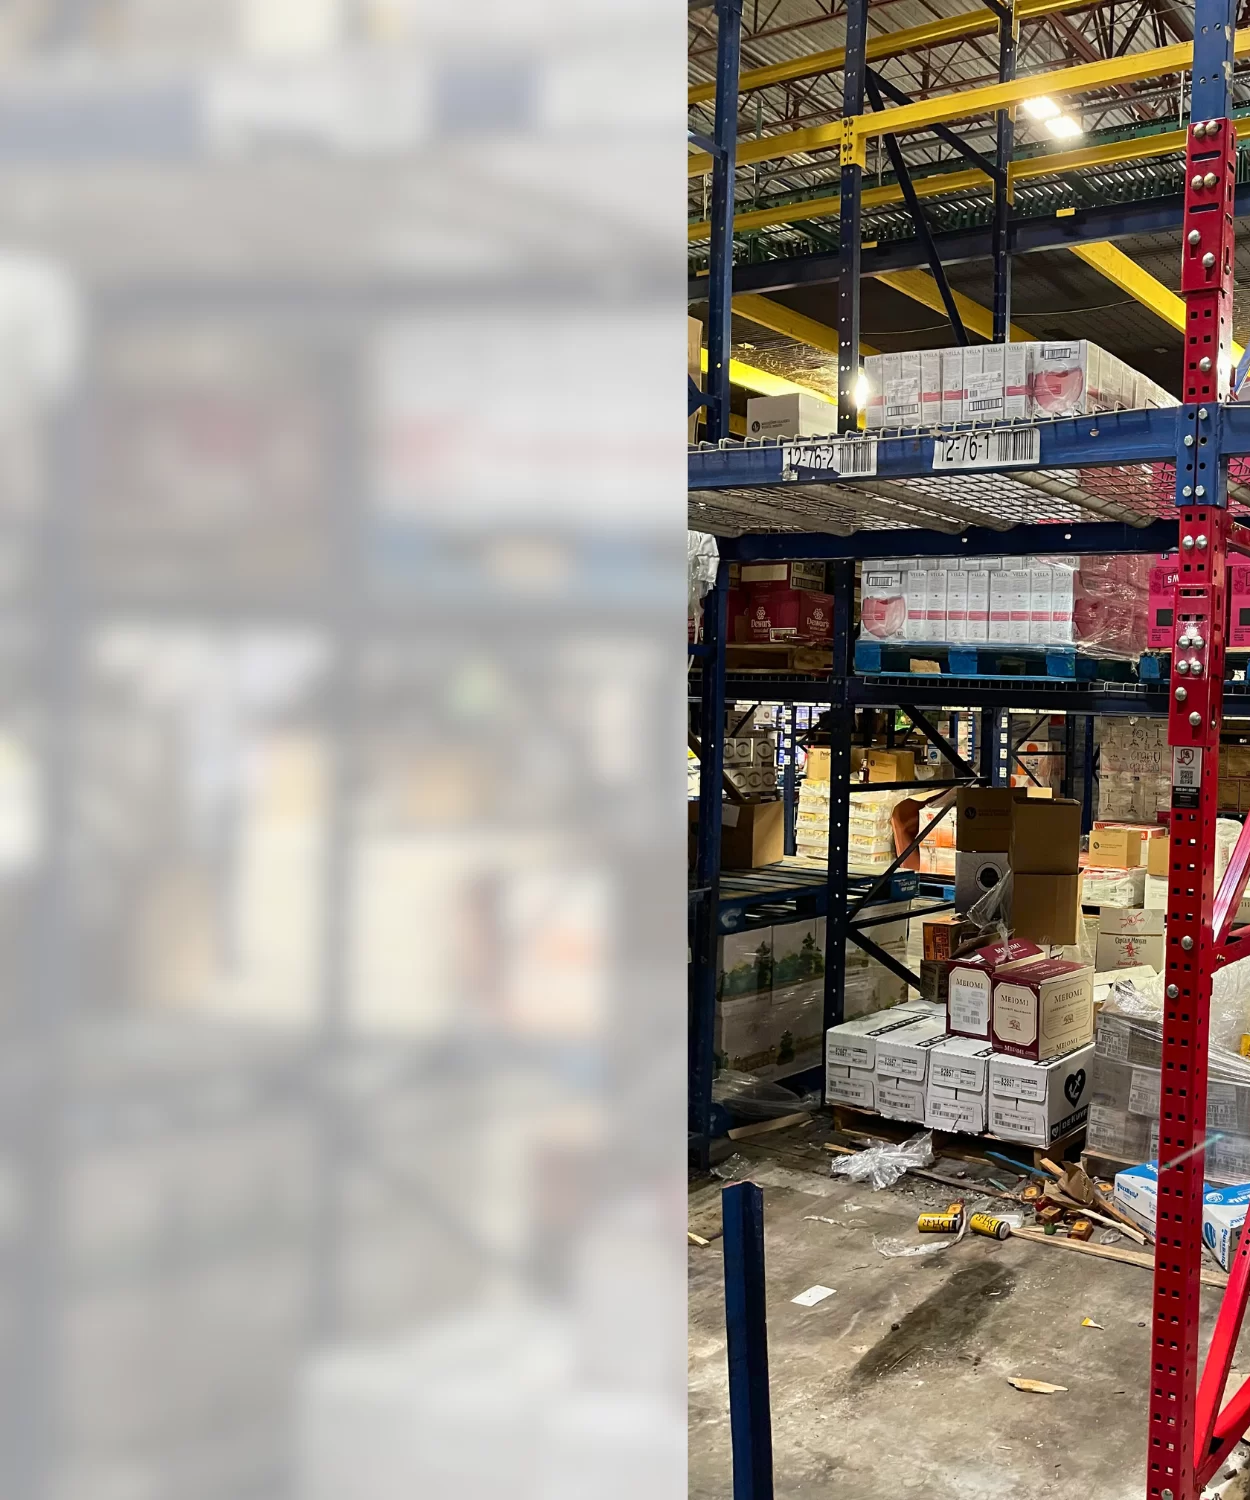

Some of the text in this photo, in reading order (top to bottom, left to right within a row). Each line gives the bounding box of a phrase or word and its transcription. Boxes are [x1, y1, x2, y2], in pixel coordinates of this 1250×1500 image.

[940, 432, 990, 462] 12-76-1
[994, 943, 1022, 954] MEOMI
[956, 978, 984, 990] MEIOMI
[1001, 994, 1029, 1007] MEIOMI
[1053, 988, 1083, 1004] MEIOMI
[1003, 1044, 1025, 1056] MEIOMI
[1055, 1037, 1078, 1051] MEIOMI
[1062, 1107, 1088, 1129] DEKUYP
